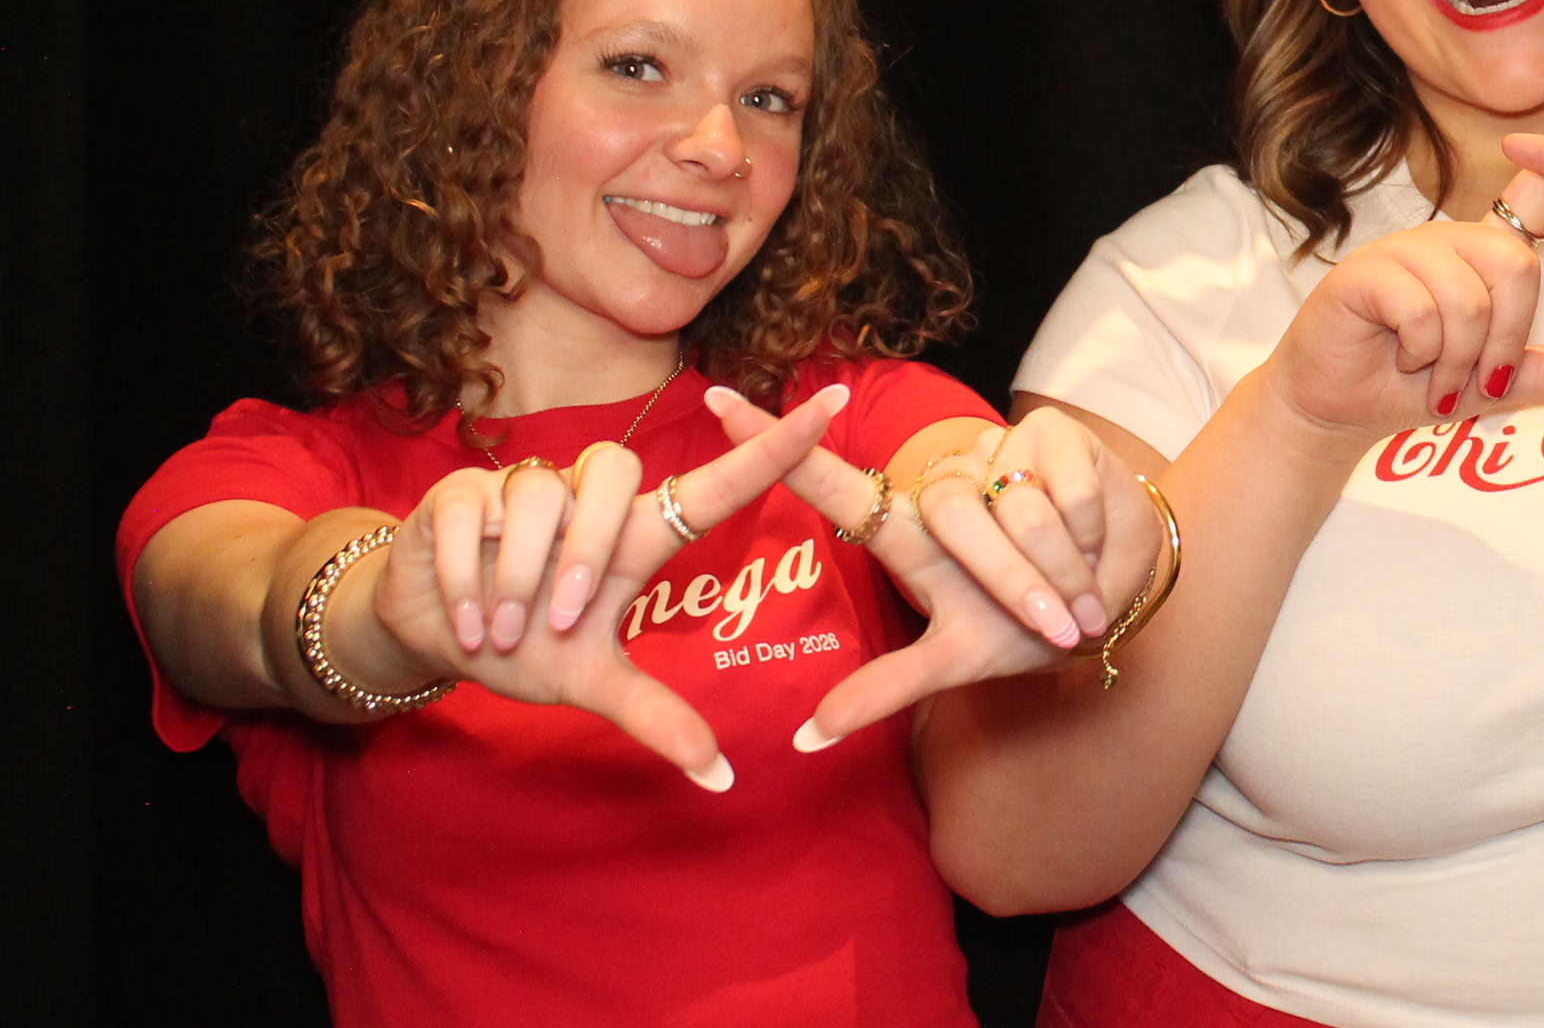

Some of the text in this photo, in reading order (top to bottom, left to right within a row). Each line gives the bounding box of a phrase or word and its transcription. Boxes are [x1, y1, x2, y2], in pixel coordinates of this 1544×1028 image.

[1375, 414, 1515, 492] Chi
[619, 539, 822, 641] mega
[714, 633, 840, 669] Bid Day 2026
